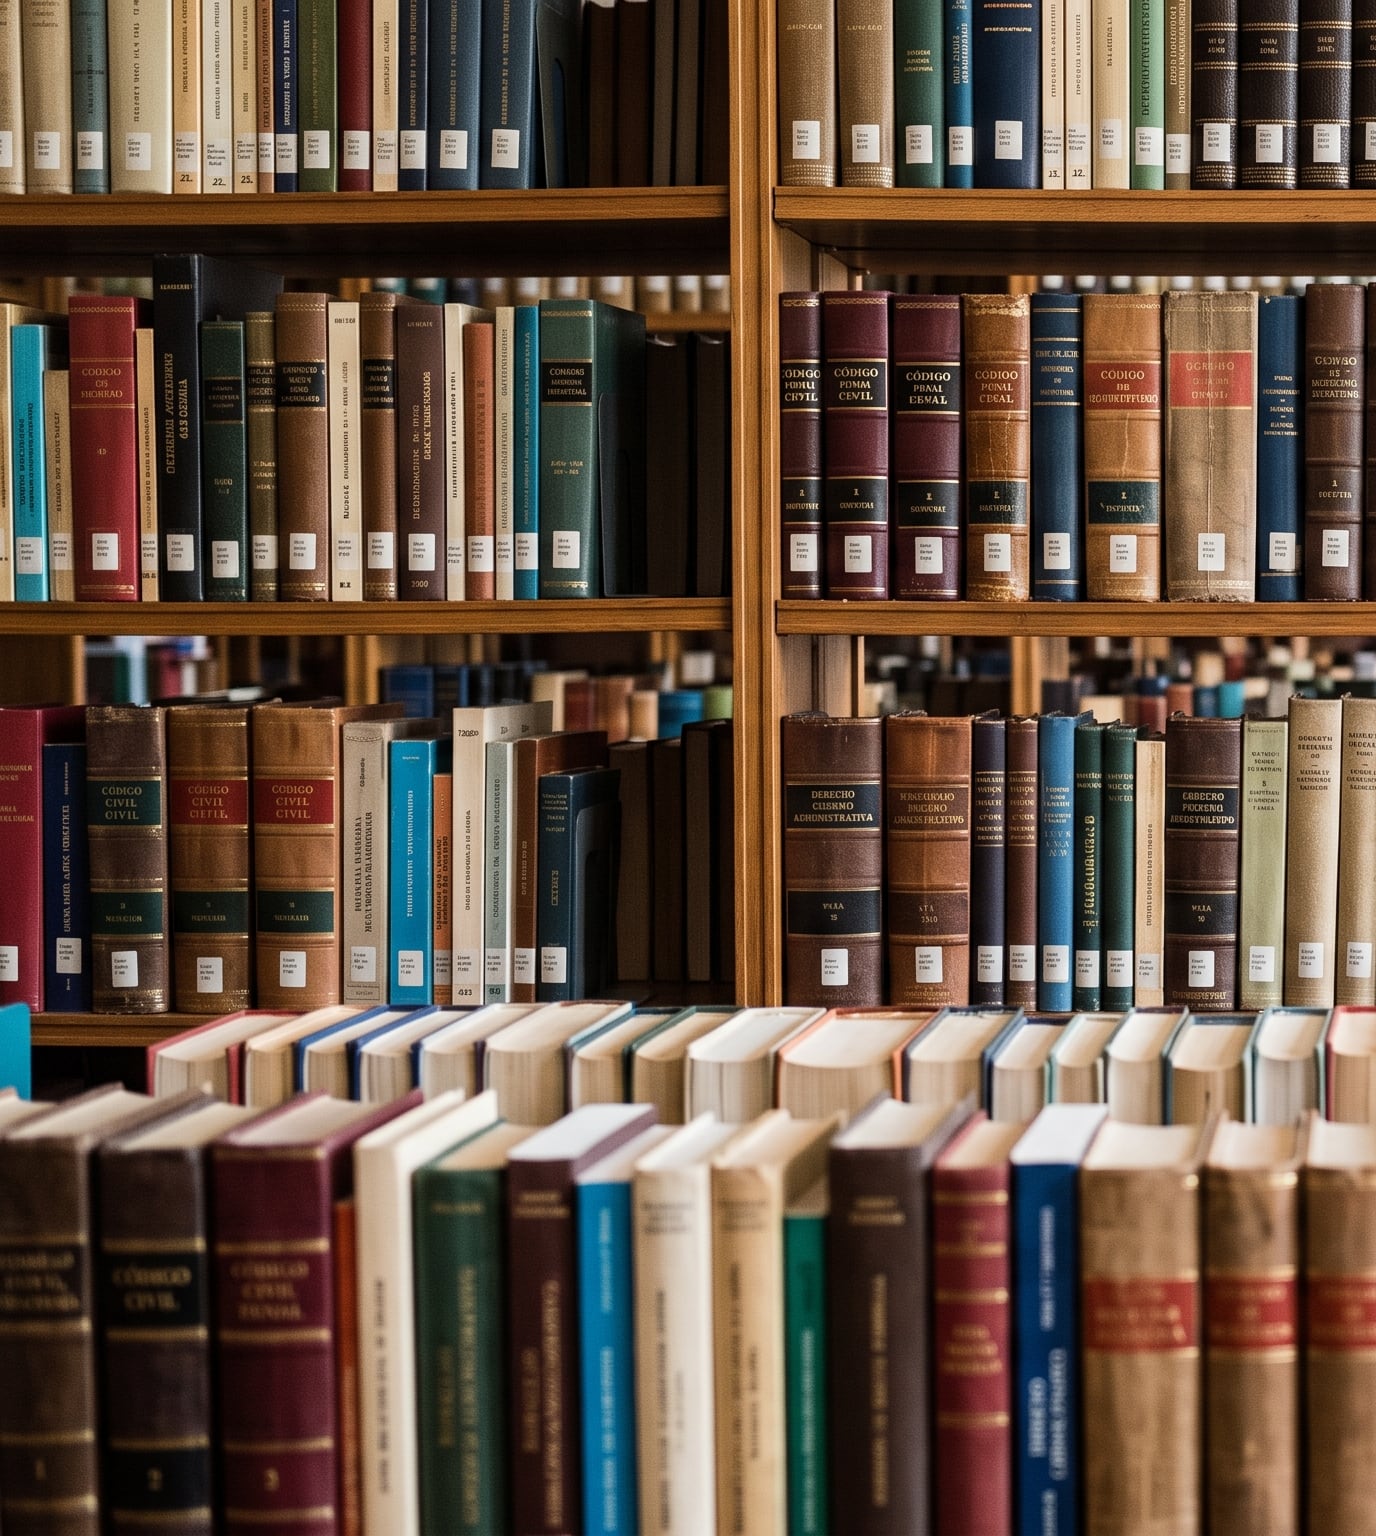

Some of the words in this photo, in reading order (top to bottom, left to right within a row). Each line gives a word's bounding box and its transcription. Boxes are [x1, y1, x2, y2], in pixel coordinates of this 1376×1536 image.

[834, 366, 879, 378] CÓDIGO
[905, 370, 951, 381] CÓDIGO
[811, 790, 856, 799] DERECHO
[275, 797, 310, 806] CIVIL
